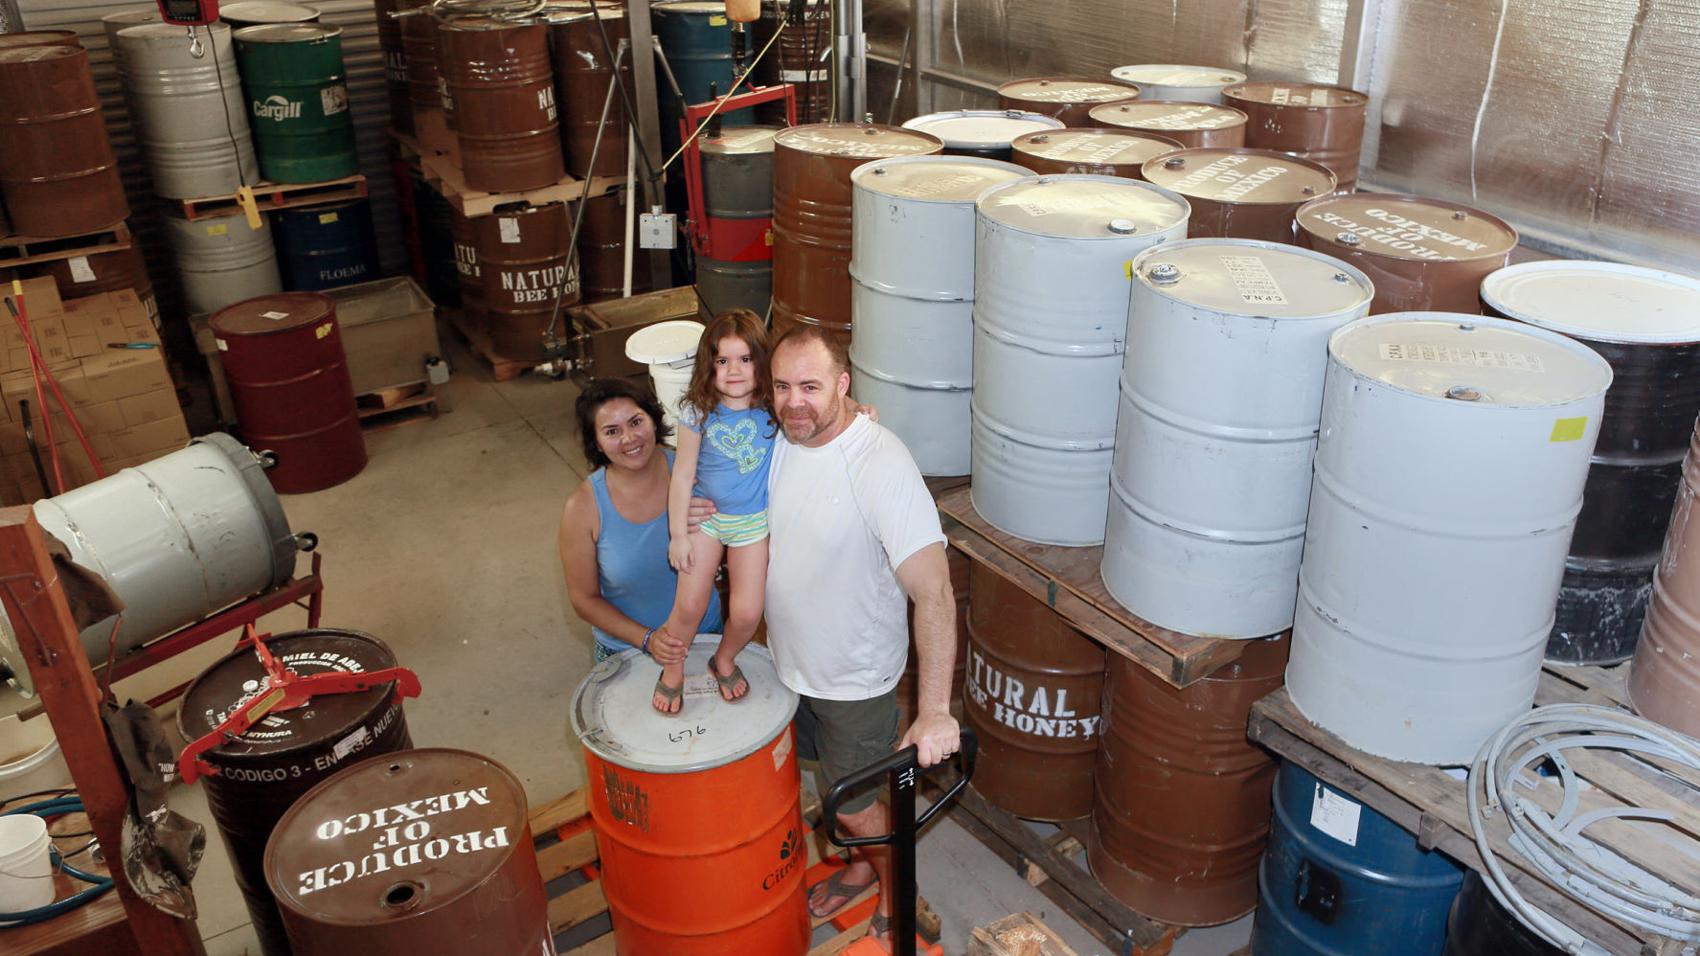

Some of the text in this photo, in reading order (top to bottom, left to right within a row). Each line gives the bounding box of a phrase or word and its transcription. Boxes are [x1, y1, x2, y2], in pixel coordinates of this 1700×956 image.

[253, 100, 301, 121] Cargill
[1167, 155, 1249, 191] PRODUCE
[1214, 166, 1288, 201] MEXICO
[1215, 169, 1246, 183] OF
[1314, 212, 1457, 260] RODUCE
[1364, 208, 1488, 251] MEXICO
[1376, 226, 1424, 241] OF
[513, 288, 548, 304] BEE
[282, 652, 316, 662] MIEL
[320, 652, 340, 661] DE
[668, 725, 706, 743] 676
[993, 702, 1101, 740] HONEY
[225, 767, 287, 782] CODIGO
[291, 765, 301, 777] 3
[315, 731, 374, 771] ENSE
[316, 786, 491, 840] MEXICO
[372, 820, 431, 850] OF
[298, 826, 510, 896] PRODUCE
